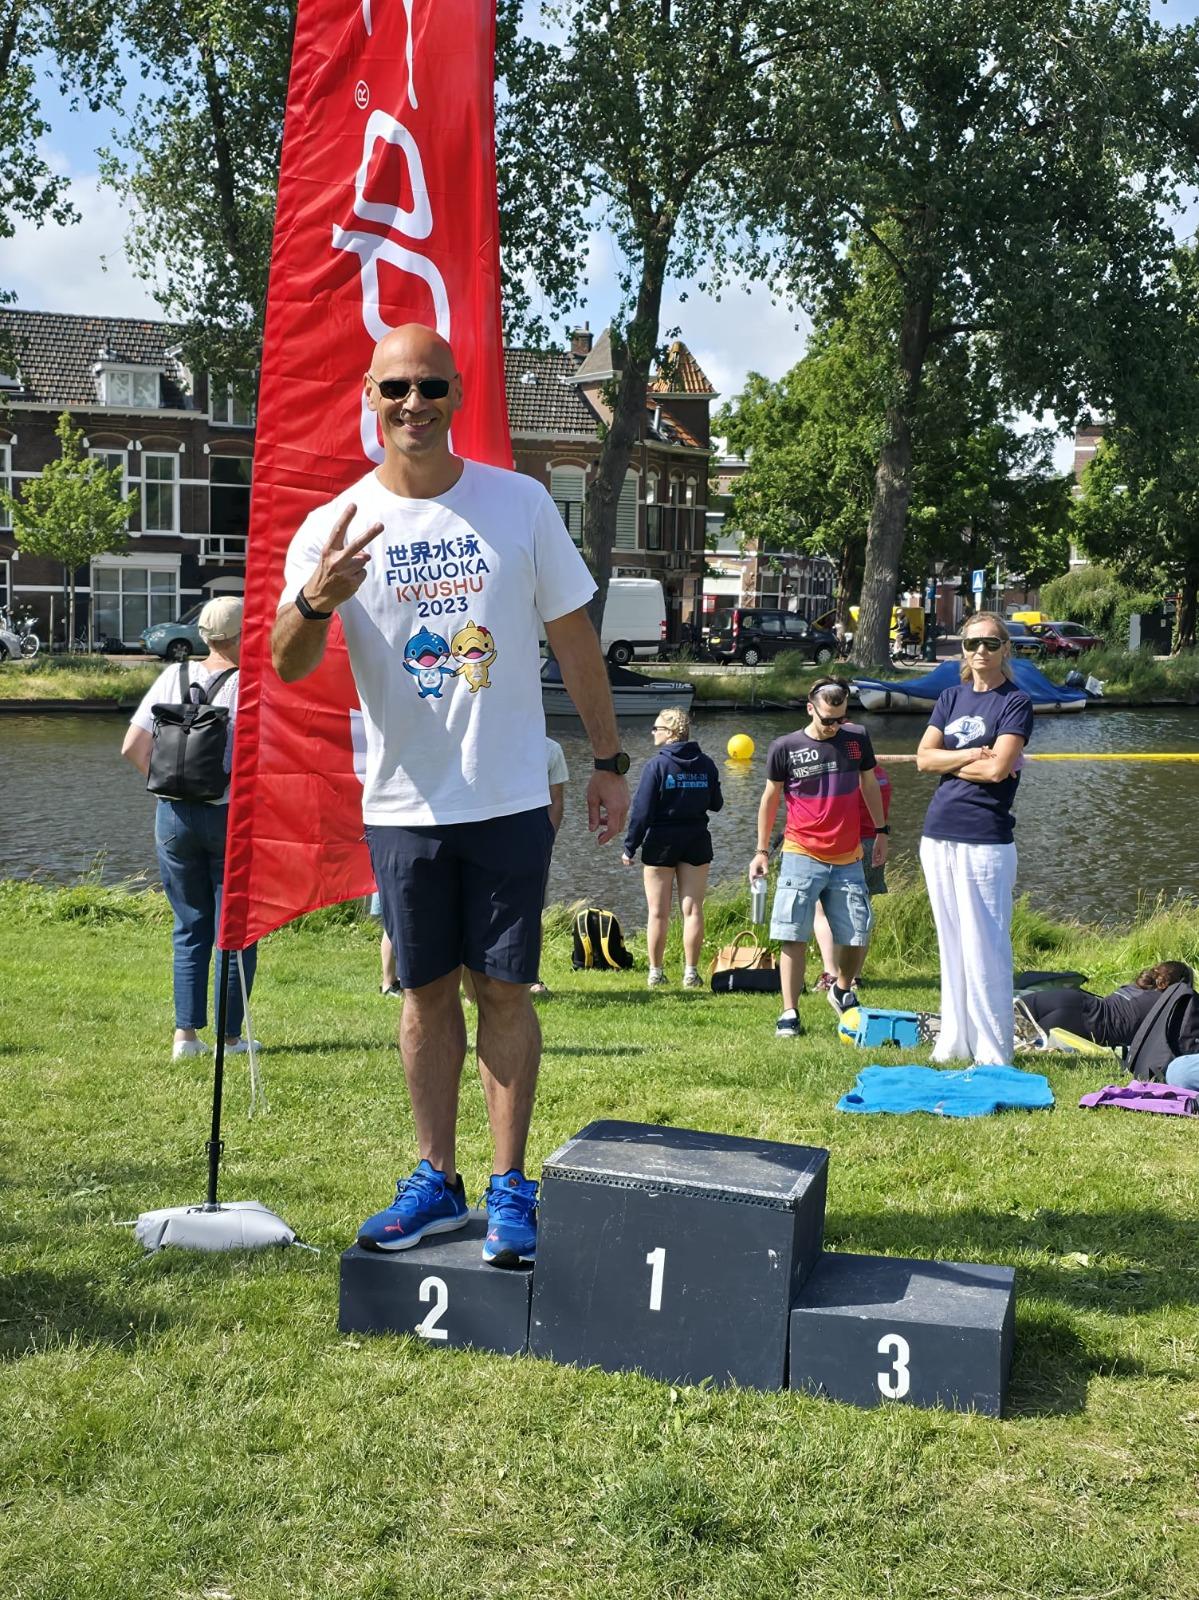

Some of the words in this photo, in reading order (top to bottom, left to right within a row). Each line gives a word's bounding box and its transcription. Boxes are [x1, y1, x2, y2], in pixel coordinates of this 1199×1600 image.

[386, 534, 482, 568] 世界水泳
[386, 558, 490, 586] FUKUOKA
[396, 576, 484, 603] KYUSHU
[417, 596, 469, 618] 2023
[645, 1246, 666, 1312] 1
[417, 1275, 449, 1341] 2
[876, 1333, 910, 1400] 3
